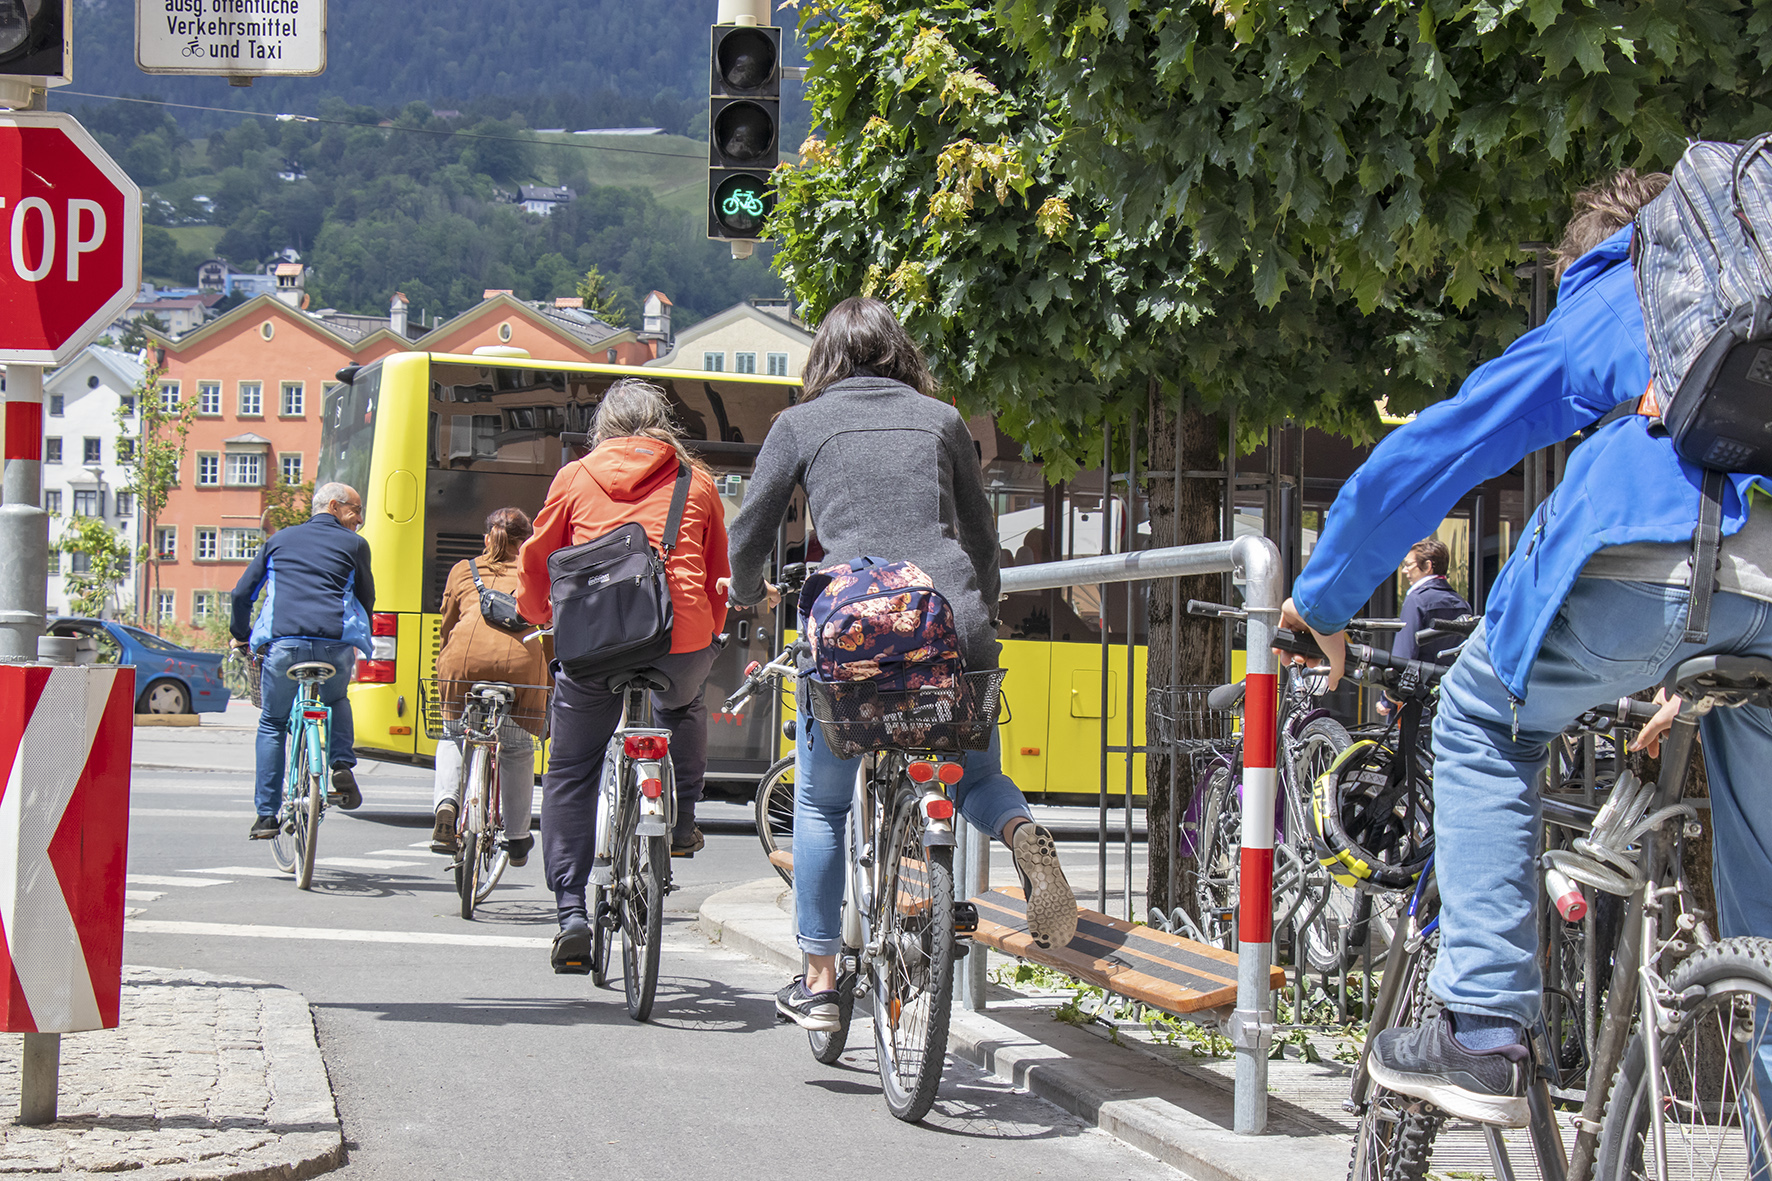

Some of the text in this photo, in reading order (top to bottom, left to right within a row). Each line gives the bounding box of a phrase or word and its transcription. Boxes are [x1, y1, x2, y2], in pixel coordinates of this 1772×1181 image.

[165, 0, 207, 17] ausg.
[167, 15, 298, 37] Verkehrsmittel
[209, 39, 283, 59] und Taxi
[0, 196, 107, 282] OP
[711, 712, 745, 727] VVT
